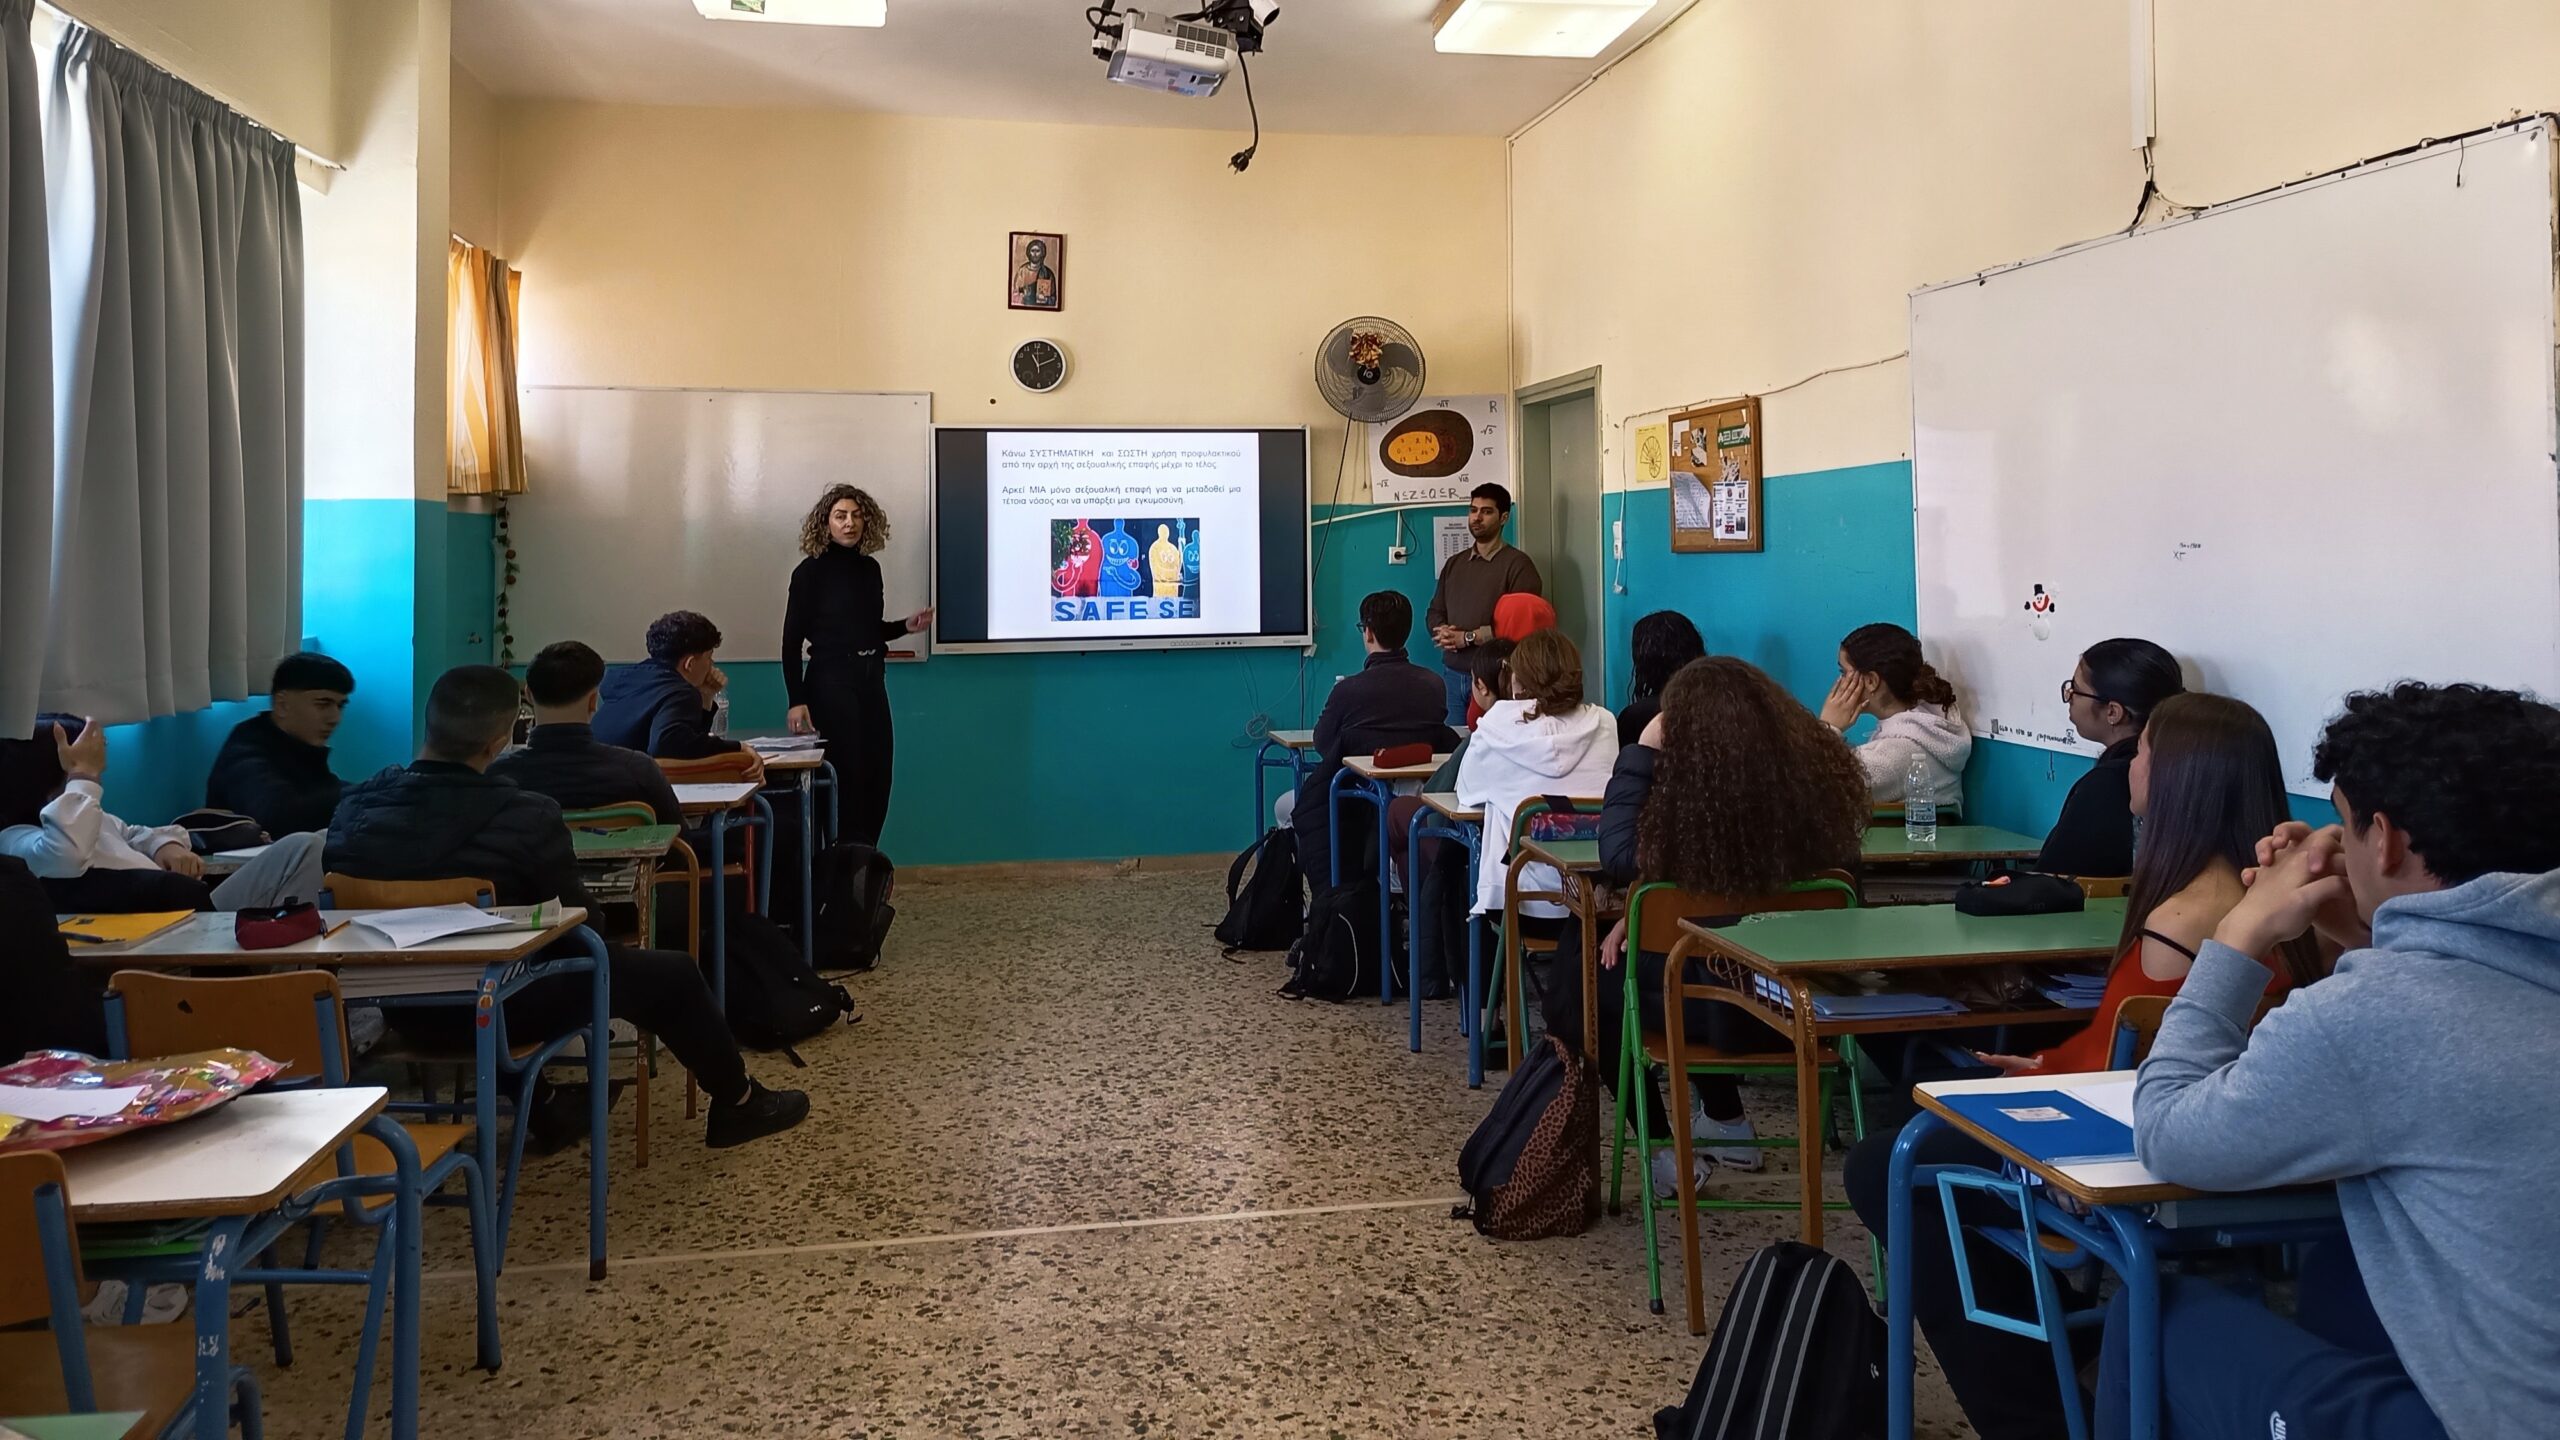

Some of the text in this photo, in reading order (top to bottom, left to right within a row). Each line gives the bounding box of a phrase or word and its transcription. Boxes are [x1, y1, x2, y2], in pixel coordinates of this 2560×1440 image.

[1489, 400, 1498, 413] R
[1002, 449, 1026, 457] Κάνω
[1030, 449, 1094, 457] ΣΥΣΤΗΜΑΤΙΚΗ
[1118, 449, 1148, 457] ΣΩΣΤΗ
[1152, 449, 1177, 459] χρήση
[1181, 449, 1241, 459] προφυλακτικού
[1022, 461, 1035, 469] την
[1038, 461, 1059, 469] αρχή
[1061, 461, 1075, 469] της
[1077, 460, 1127, 470] σεξουαλικής
[1128, 461, 1159, 470] επαφής
[1161, 461, 1182, 470] μέχρι
[1002, 486, 1025, 495] Αρκεί
[1050, 486, 1071, 495] μόνο
[1075, 486, 1121, 495] σεξουαλική
[1125, 485, 1151, 495] επαφή
[1155, 487, 1168, 495] για
[1186, 485, 1225, 495] μεταδοθεί
[1229, 486, 1242, 494] μια
[1029, 497, 1055, 506] νόσος
[1084, 497, 1116, 506] υπάρξει
[1055, 600, 1195, 621] SAFE SE
